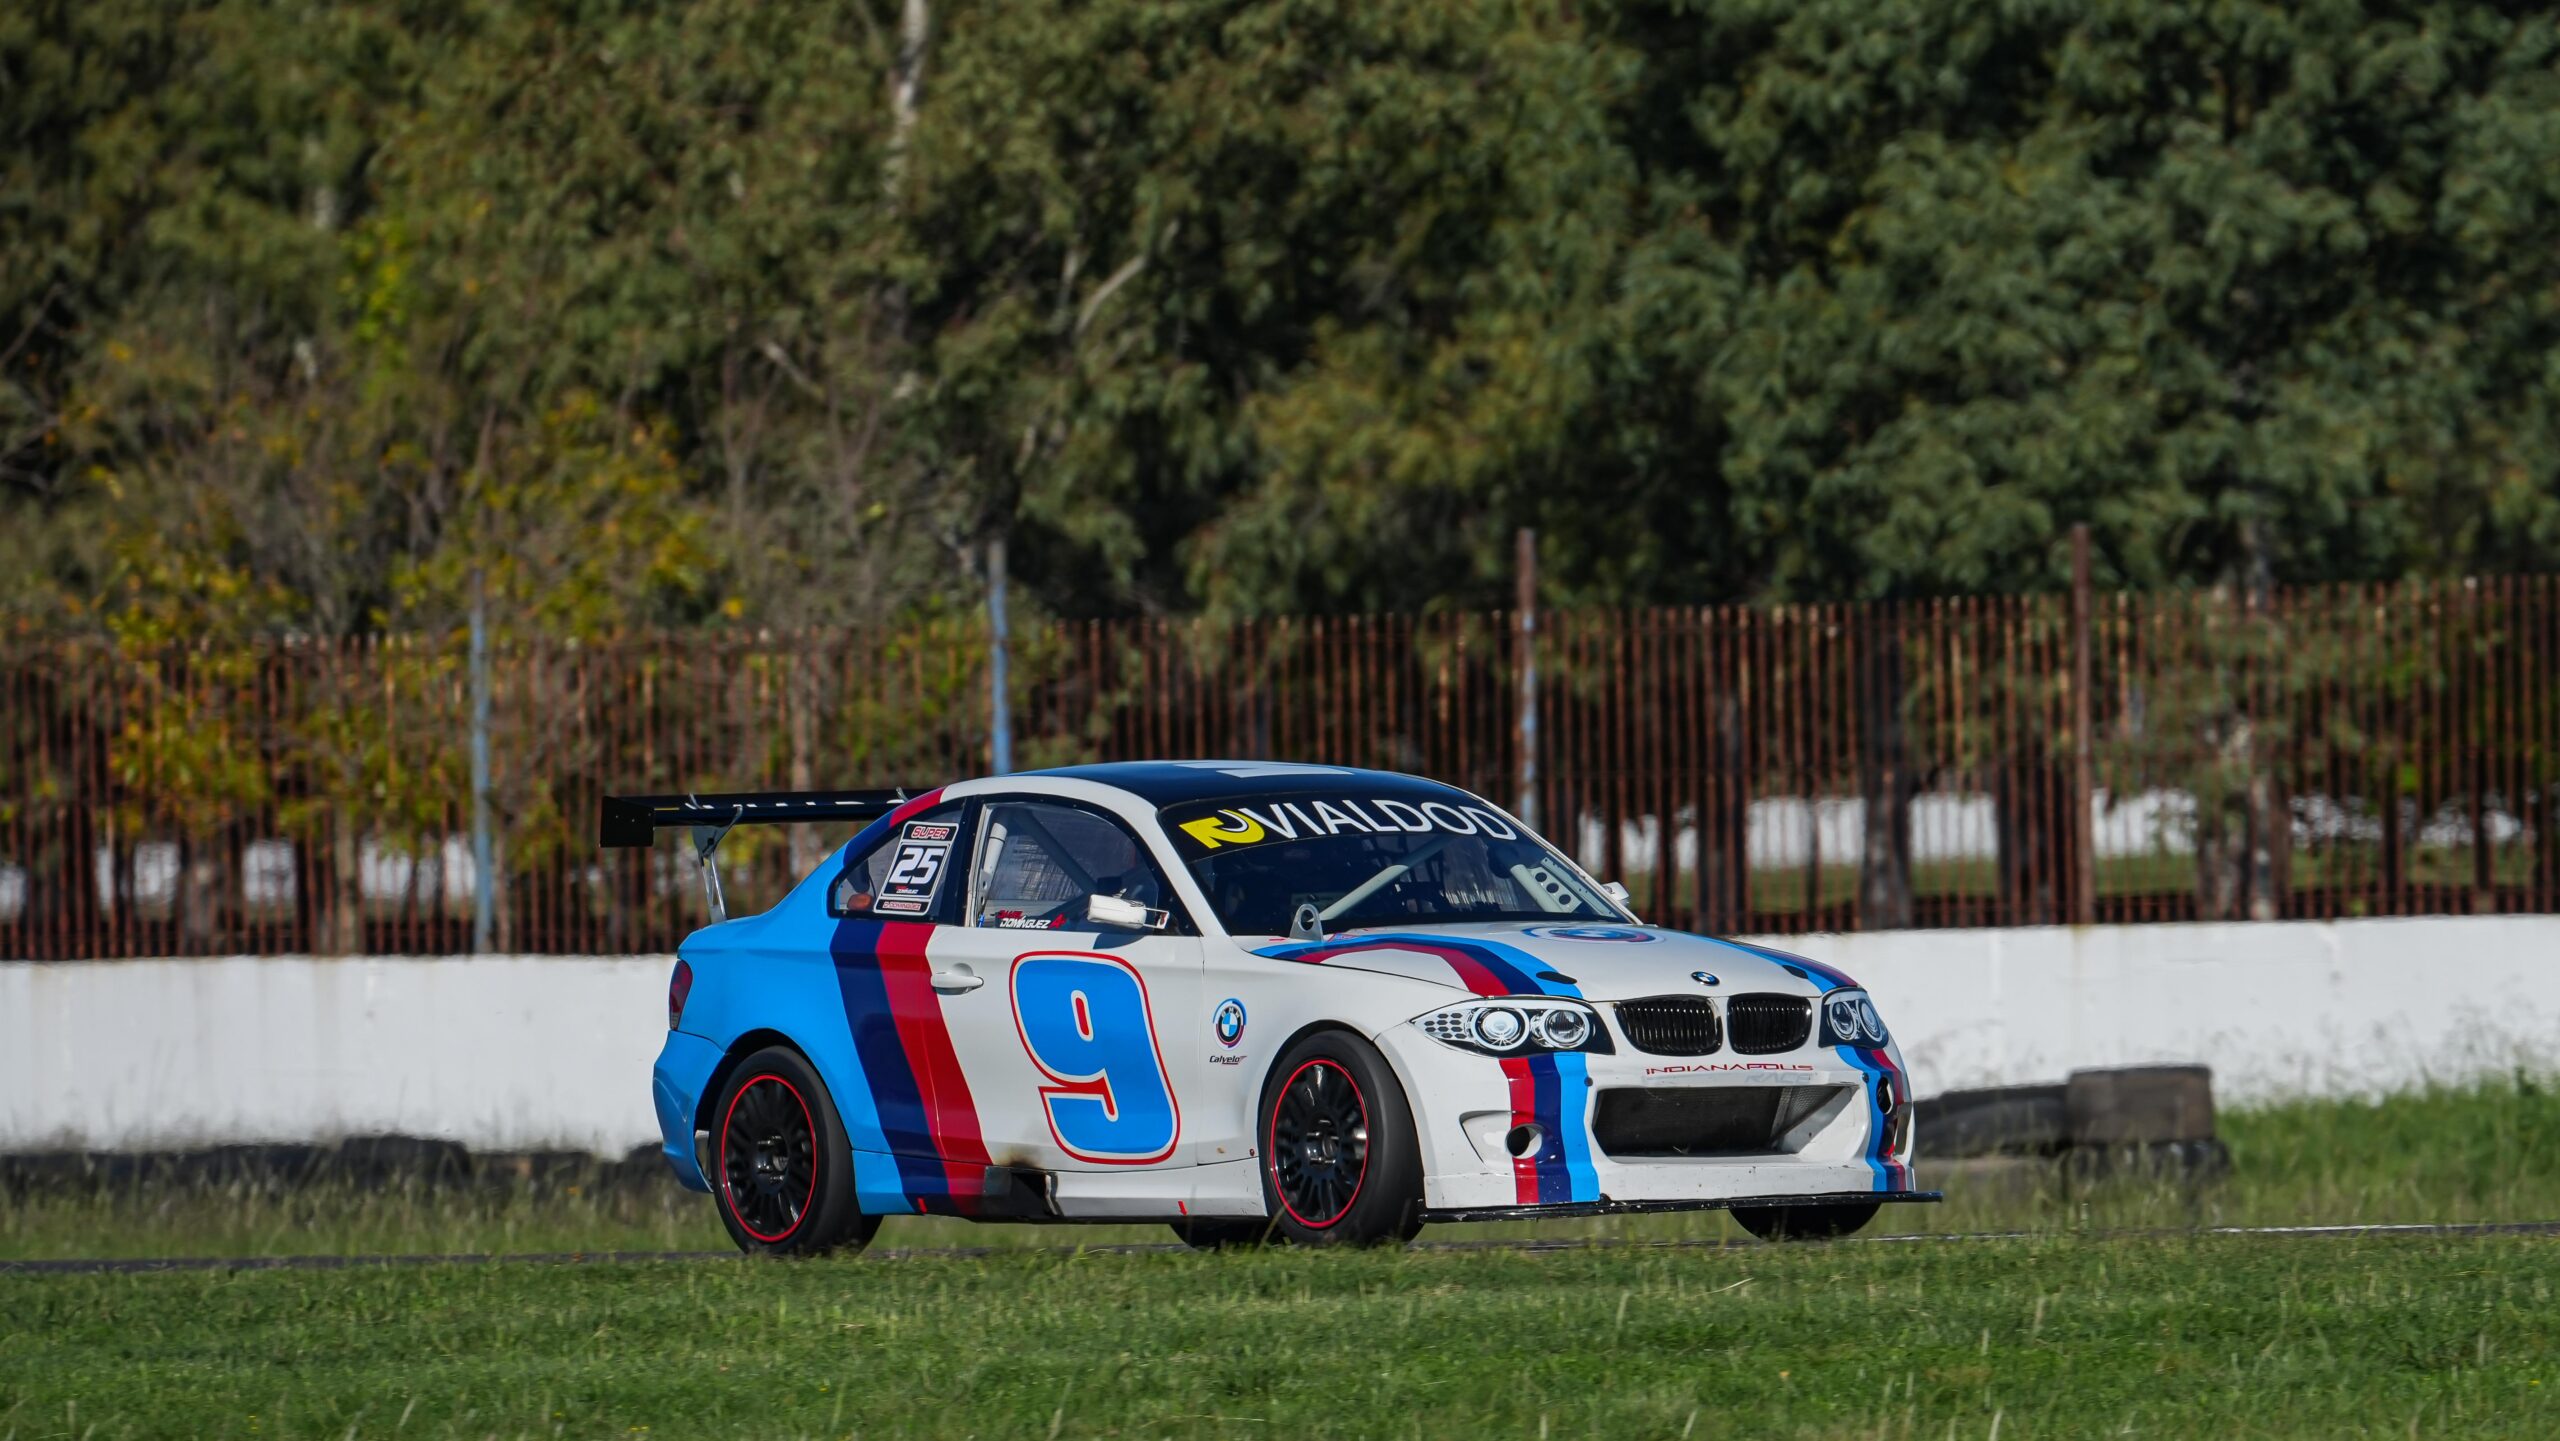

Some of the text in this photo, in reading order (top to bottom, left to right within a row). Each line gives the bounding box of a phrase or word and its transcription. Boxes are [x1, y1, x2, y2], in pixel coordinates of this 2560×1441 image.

[911, 826, 949, 839] SUPER
[1238, 800, 1517, 840] VIALDOD
[889, 847, 944, 884] 25
[1009, 950, 1181, 1165] 9
[1209, 1055, 1240, 1065] Calvelo
[1646, 1063, 1814, 1075] INDIANAPOLIS
